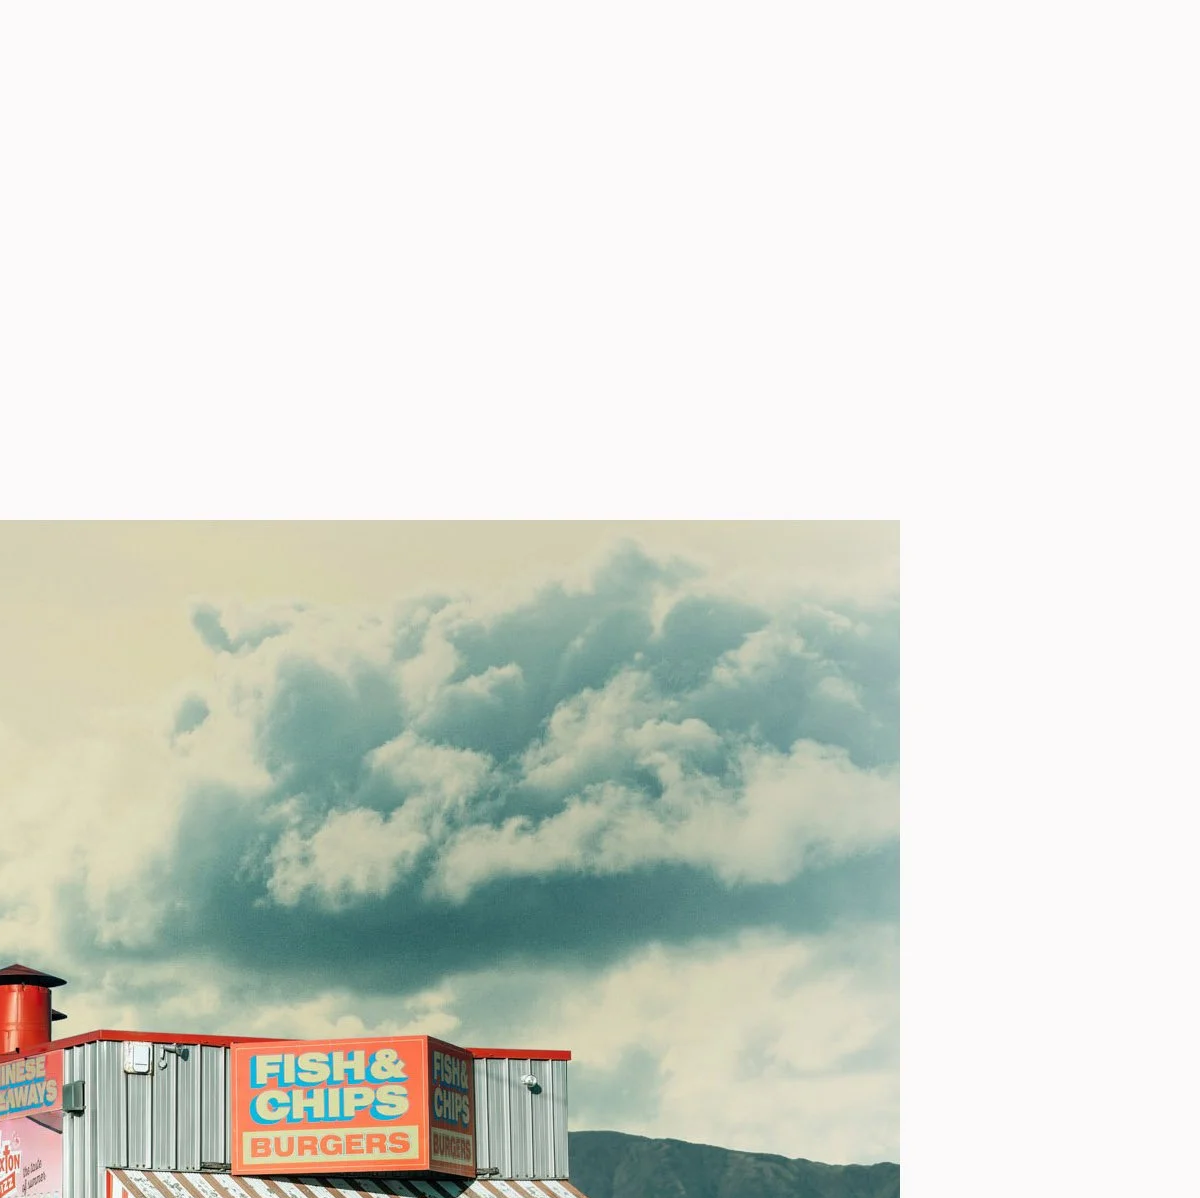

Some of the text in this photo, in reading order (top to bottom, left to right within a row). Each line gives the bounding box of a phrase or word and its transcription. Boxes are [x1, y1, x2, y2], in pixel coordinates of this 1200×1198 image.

[250, 1085, 409, 1125] CHIPS
[433, 1087, 470, 1129] CHIPS
[251, 1132, 411, 1158] BURGERS
[432, 1133, 471, 1161] BURGERS
